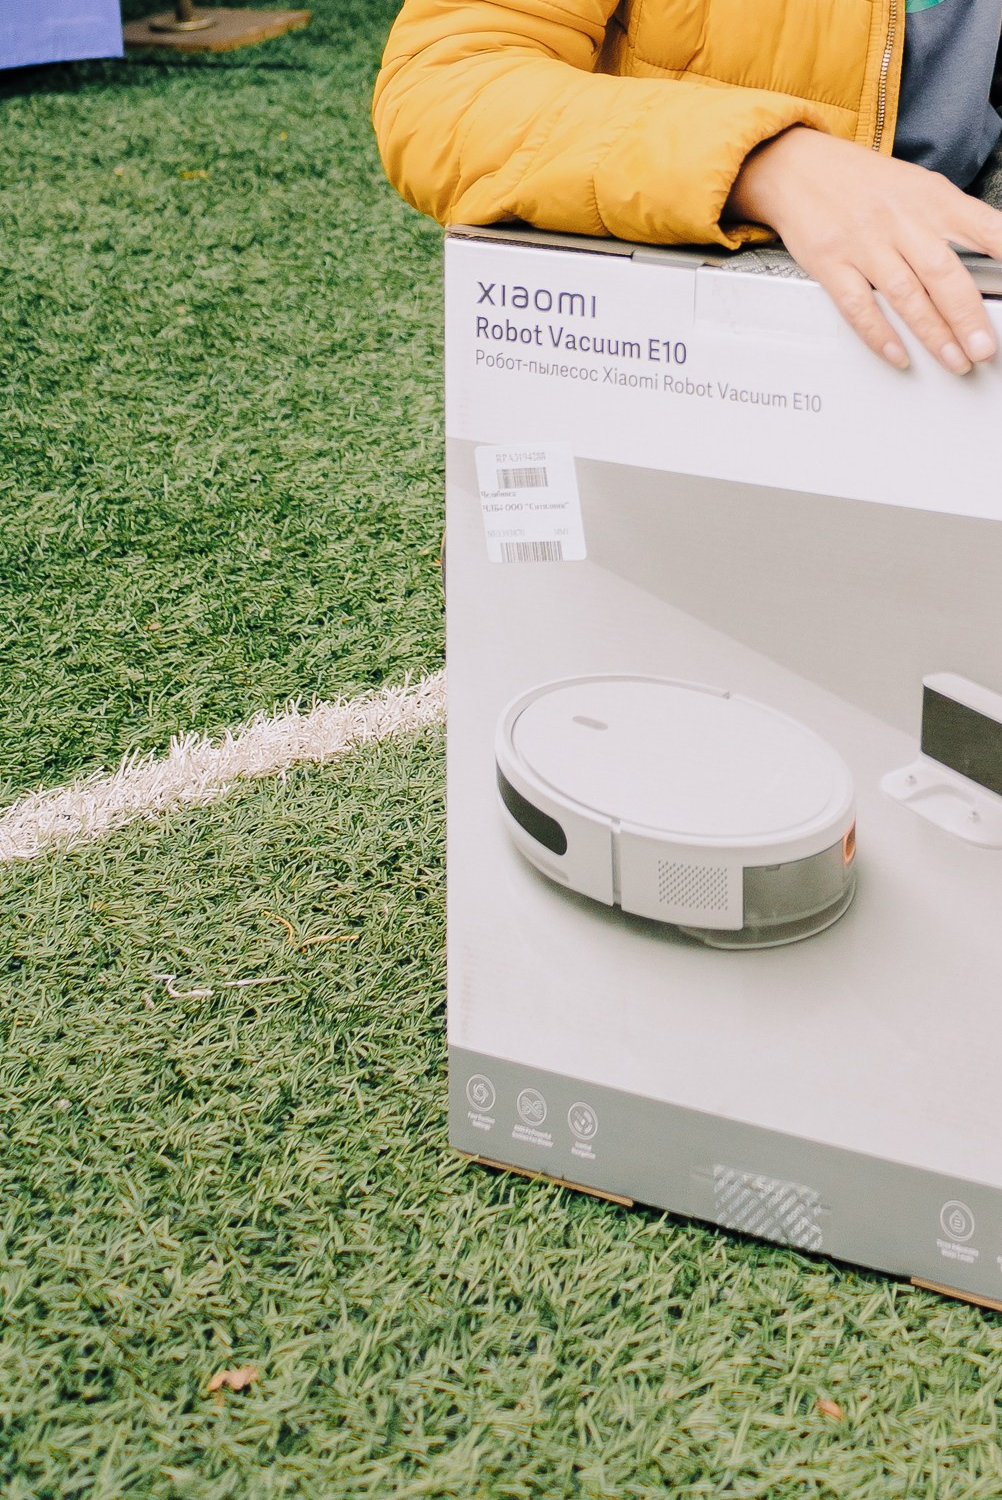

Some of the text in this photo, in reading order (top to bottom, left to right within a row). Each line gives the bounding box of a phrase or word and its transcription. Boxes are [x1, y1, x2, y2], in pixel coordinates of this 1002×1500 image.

[476, 316, 687, 365] Robot Vacuum E10
[475, 349, 822, 413] Робот-пылесос Xiaomi Robot Vacuum E10
